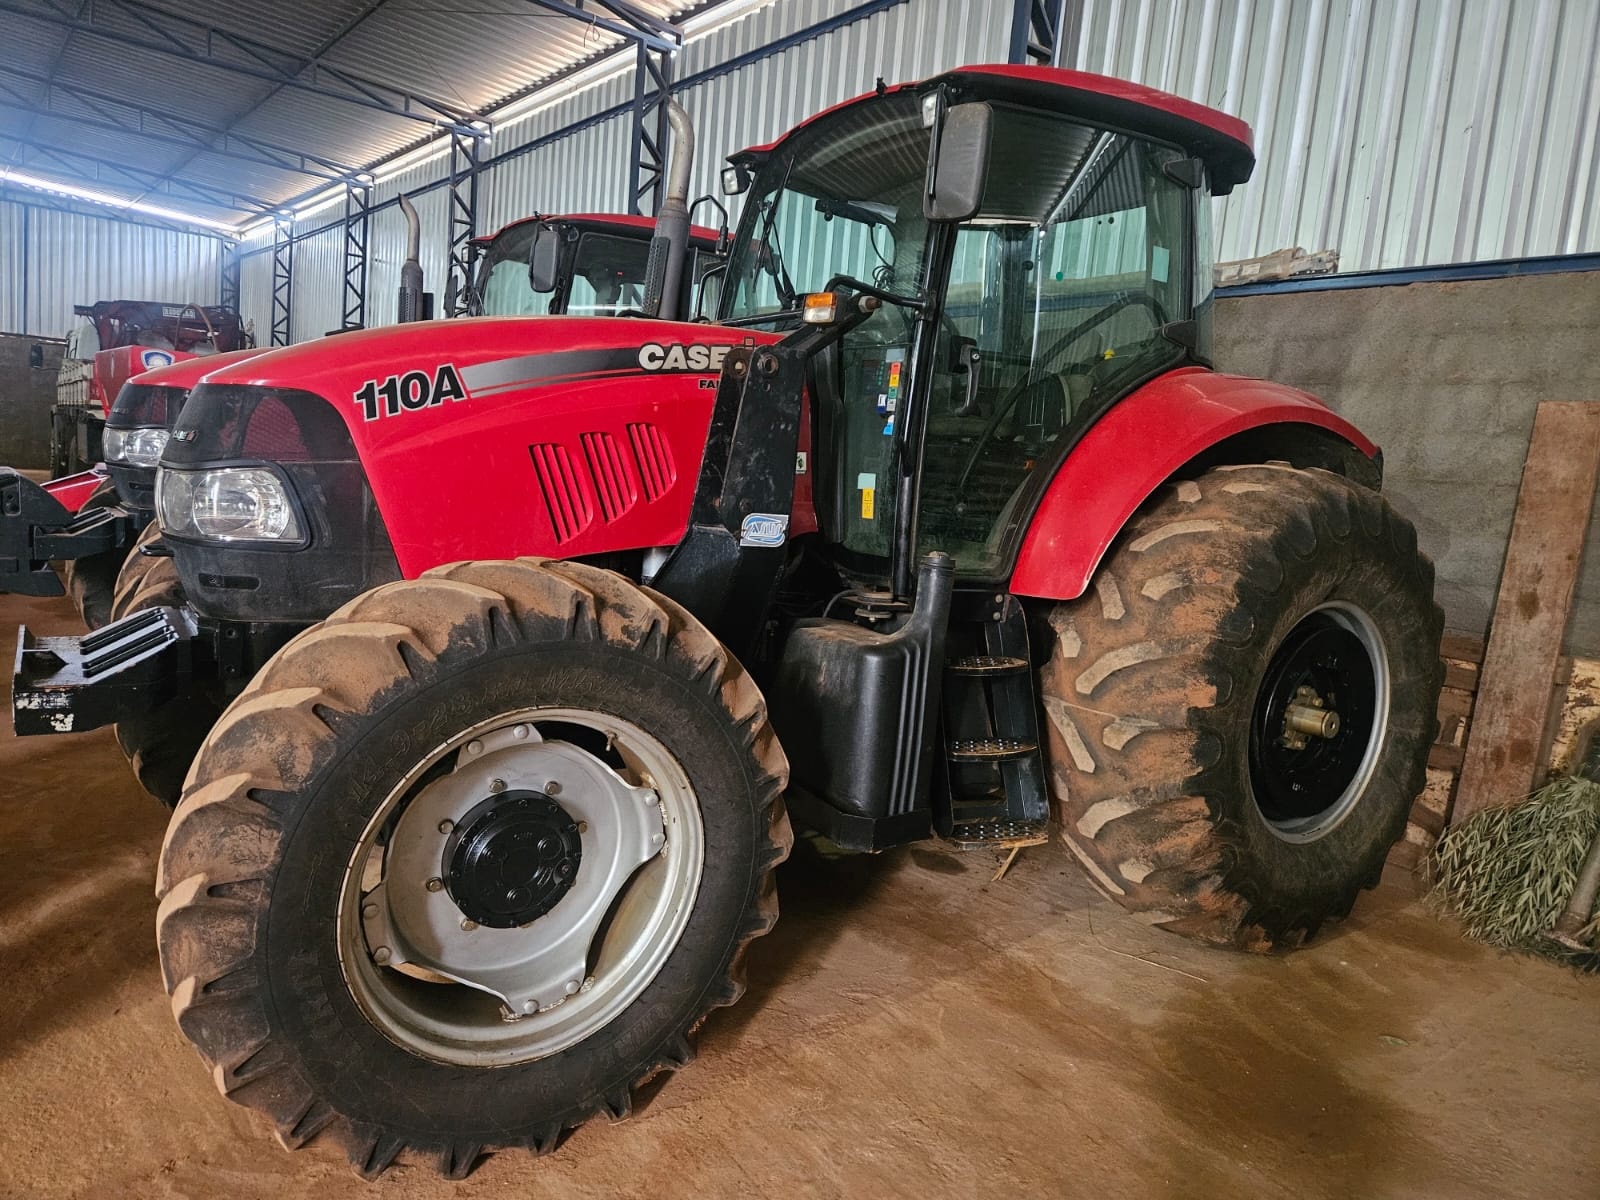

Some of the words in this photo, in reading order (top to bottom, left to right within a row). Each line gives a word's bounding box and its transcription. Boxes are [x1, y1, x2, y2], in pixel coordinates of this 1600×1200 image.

[637, 344, 731, 371] CASE
[354, 363, 466, 421] 110A
[699, 379, 721, 390] FA
